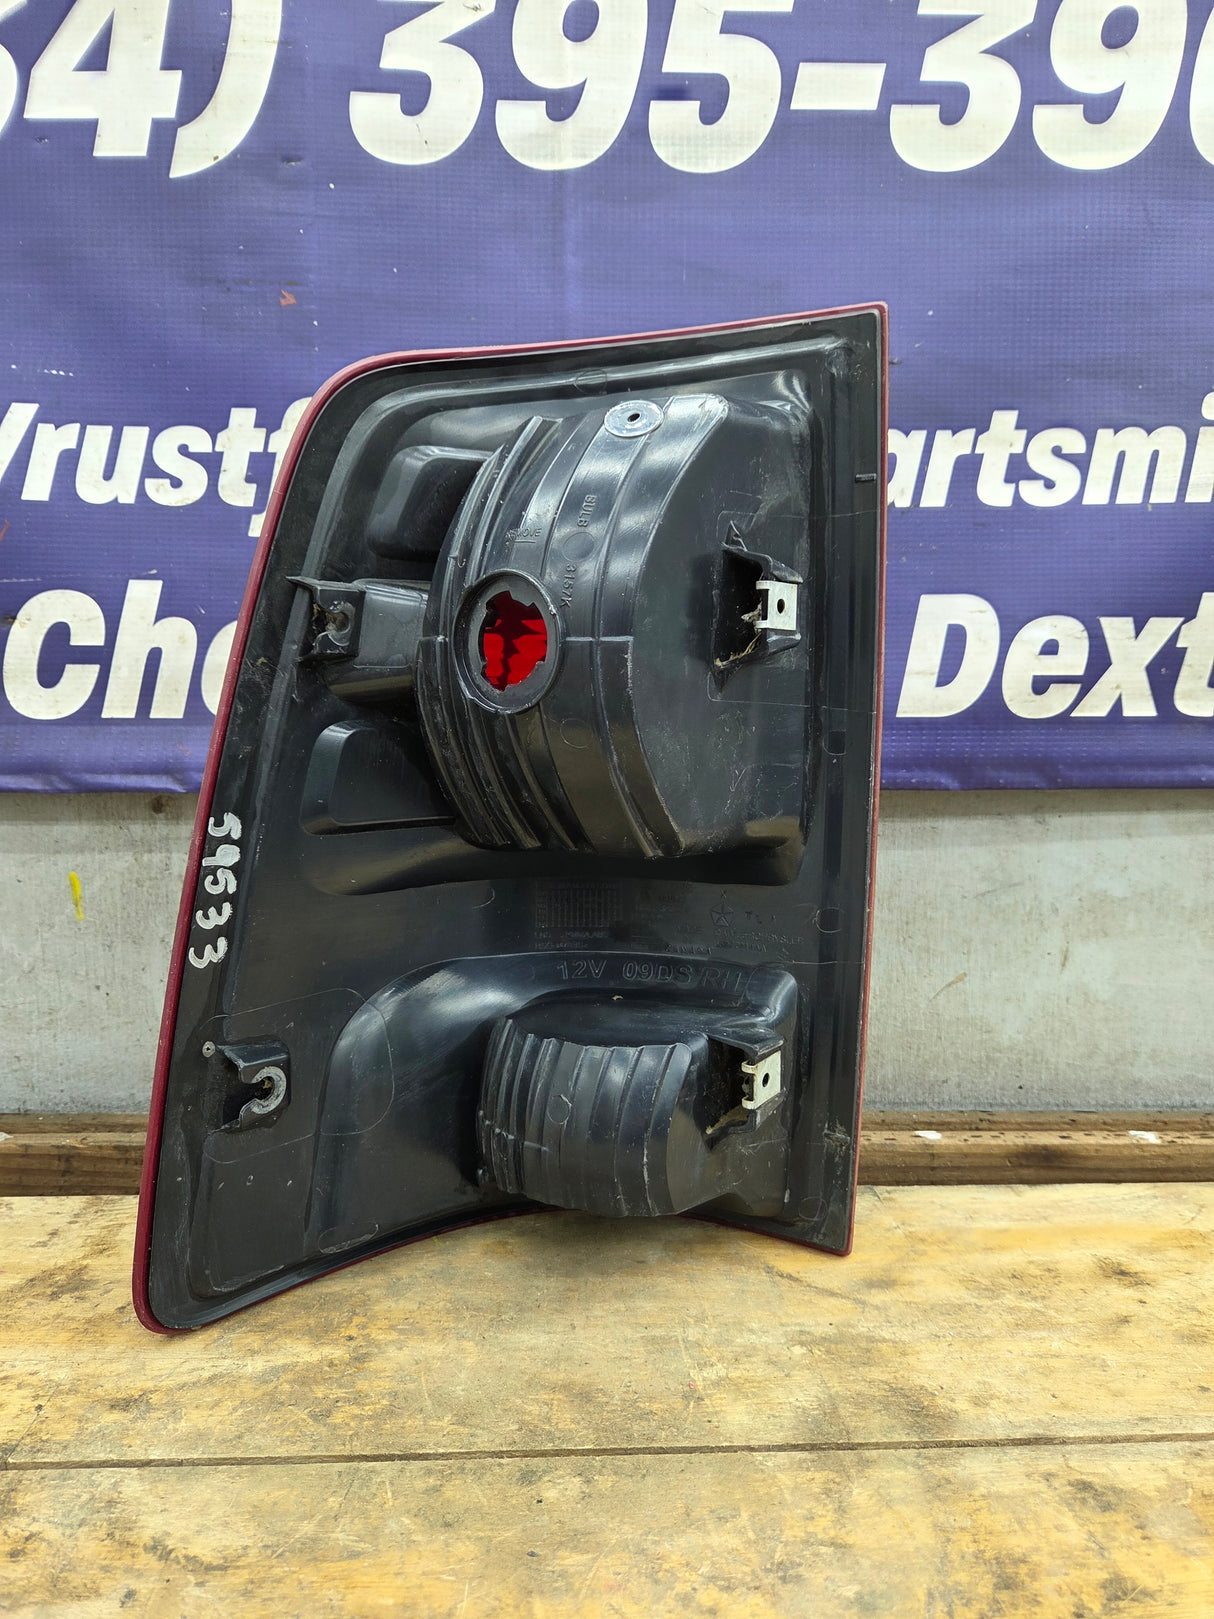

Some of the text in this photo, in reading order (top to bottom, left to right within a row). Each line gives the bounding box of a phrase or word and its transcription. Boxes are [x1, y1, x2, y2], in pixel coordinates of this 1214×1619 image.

[0, 0, 1214, 178] 4) 395-39
[188, 812, 242, 969] 59533
[556, 959, 608, 981] 12V
